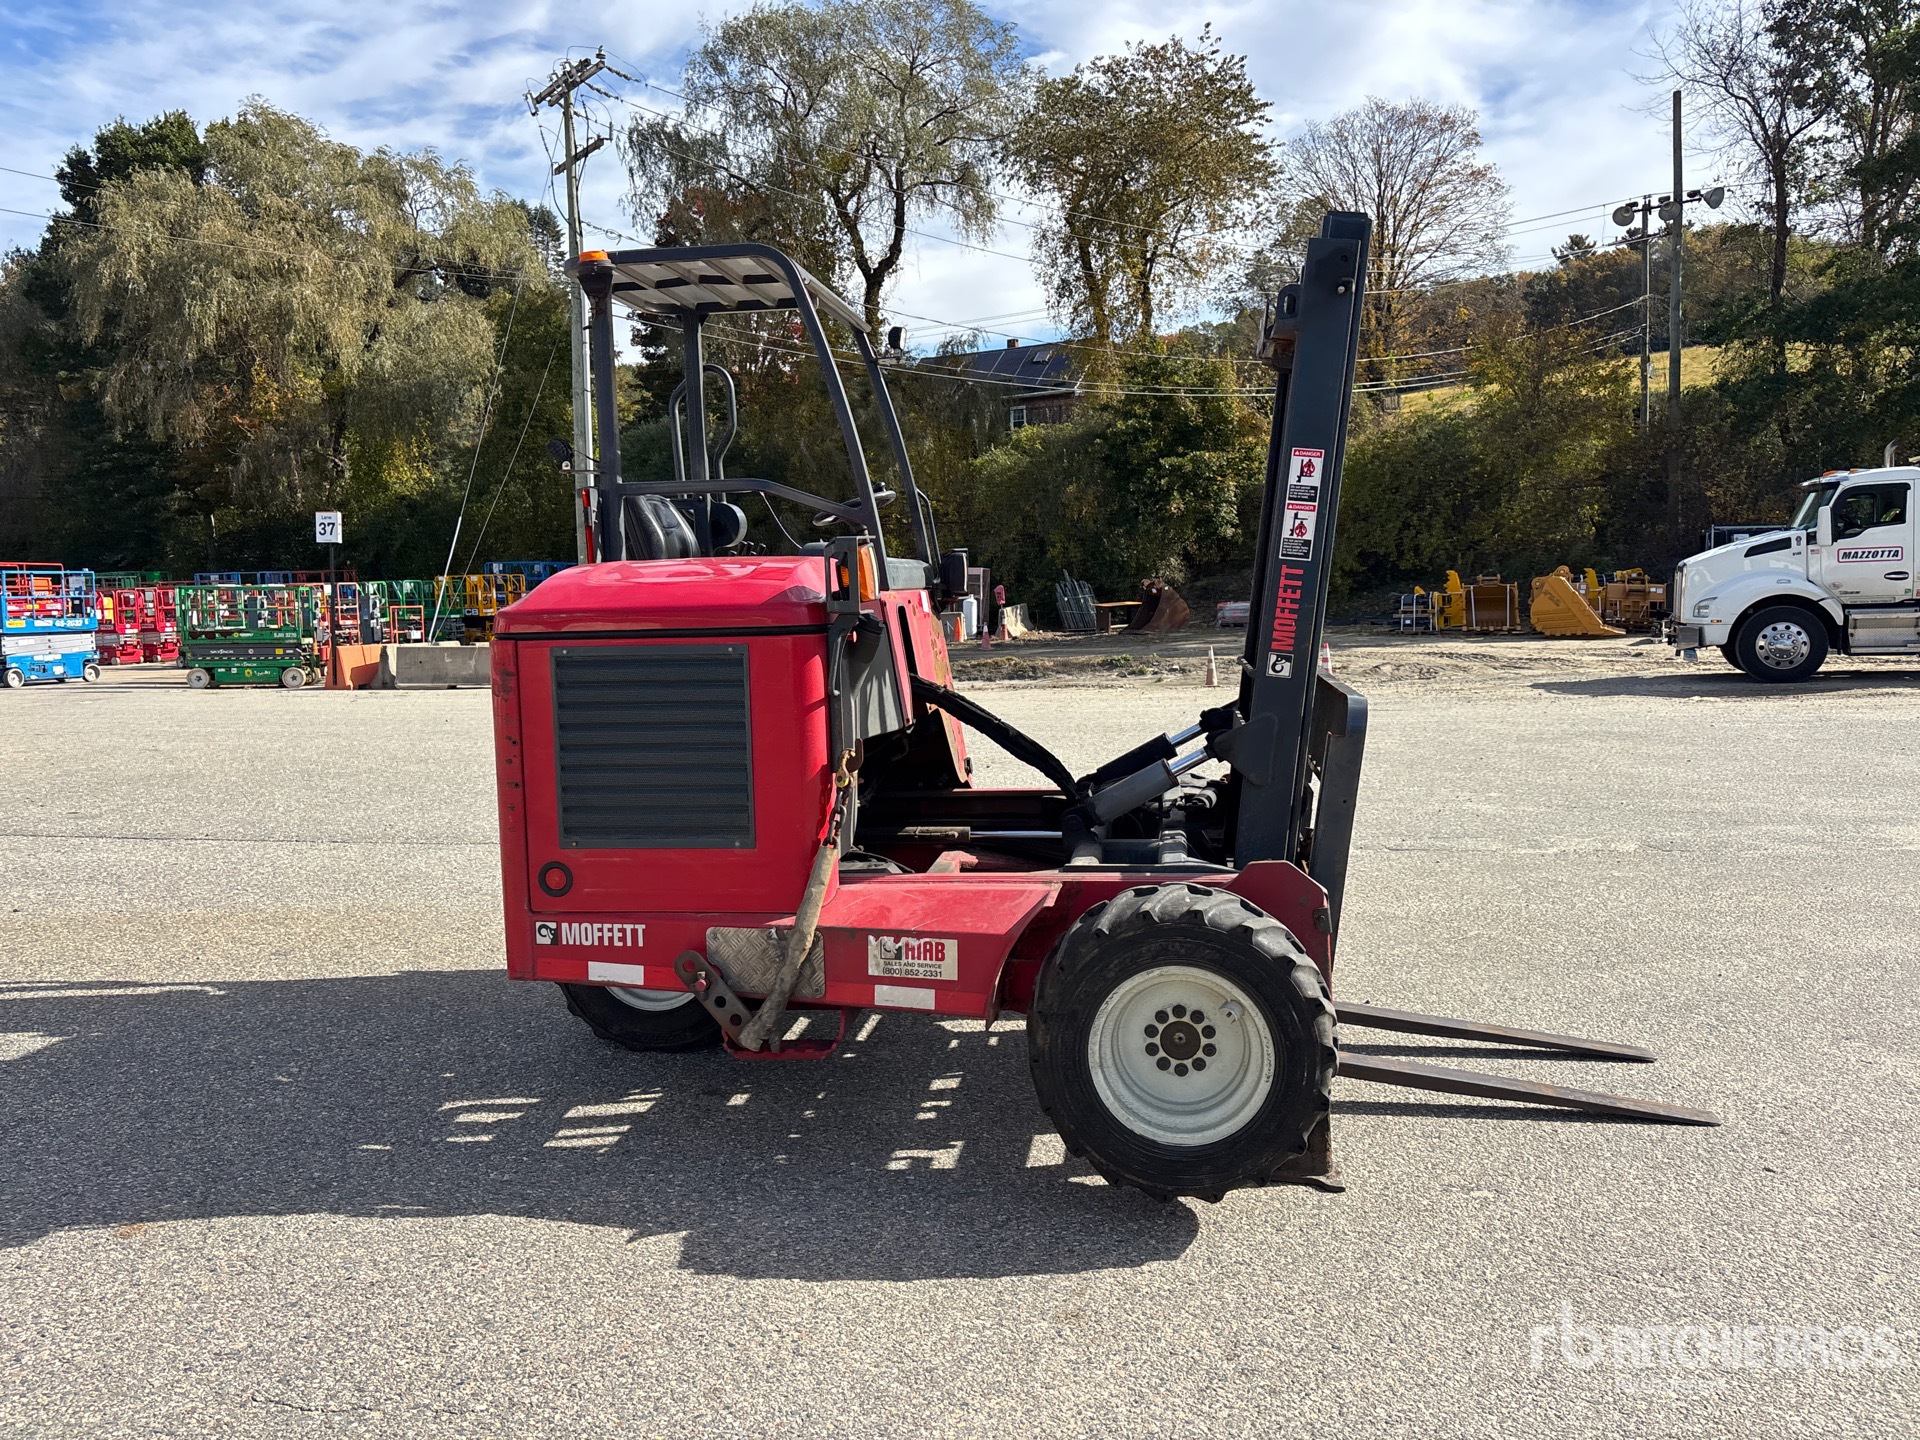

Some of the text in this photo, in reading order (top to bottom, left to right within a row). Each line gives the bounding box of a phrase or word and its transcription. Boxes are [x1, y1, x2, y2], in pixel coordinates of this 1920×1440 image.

[318, 522, 336, 536] 37
[1841, 549, 1900, 560] MAZZOTTA
[464, 608, 479, 616] CB
[1271, 565, 1304, 651] MOFFETT
[561, 922, 646, 947] MOFFETT
[904, 939, 946, 962] HIAB
[882, 967, 943, 978] (800) 852-2331
